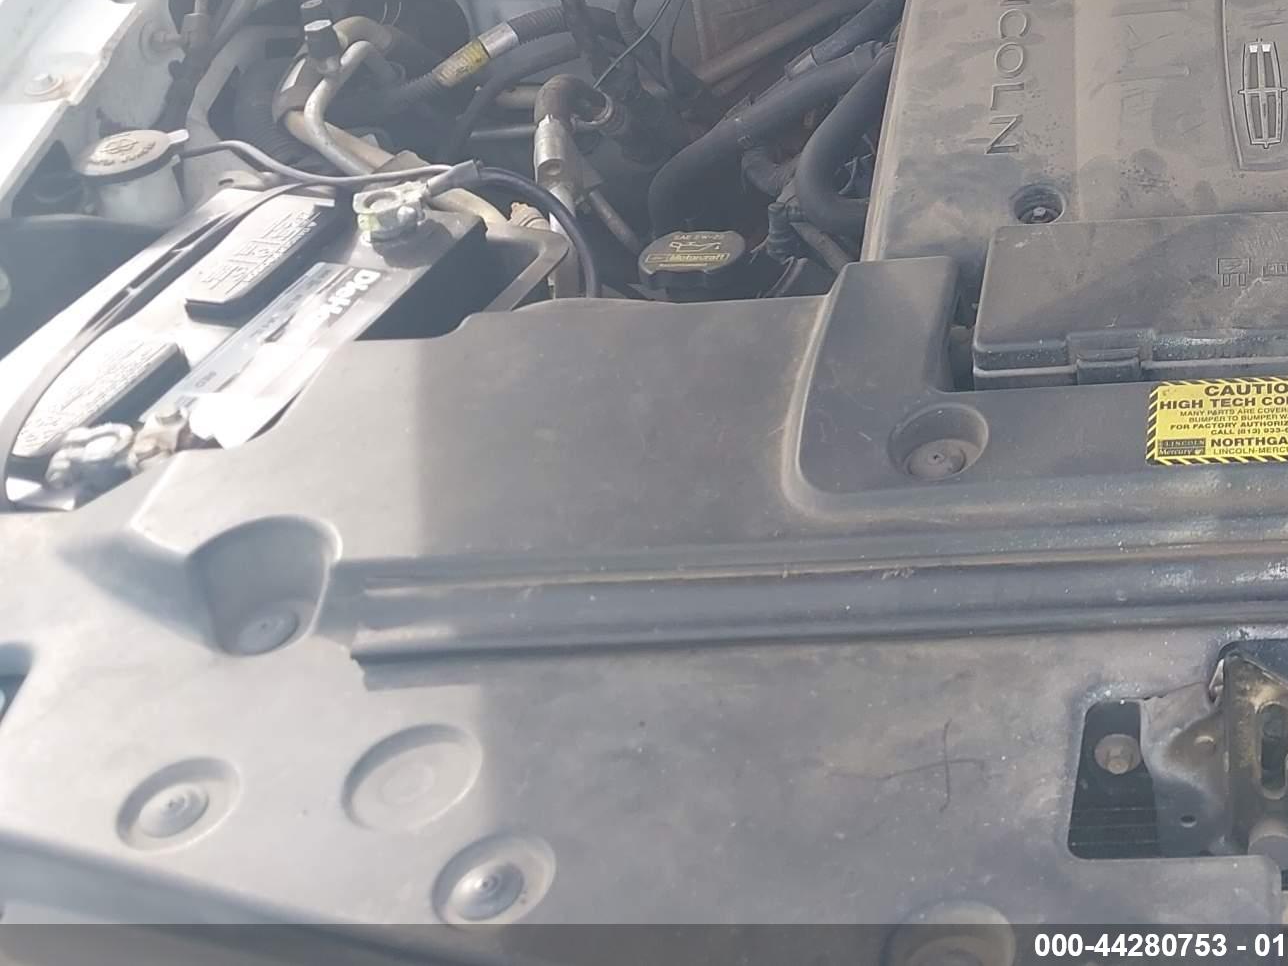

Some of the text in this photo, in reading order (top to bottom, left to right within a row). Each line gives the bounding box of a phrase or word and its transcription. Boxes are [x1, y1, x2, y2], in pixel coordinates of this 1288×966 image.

[1160, 399, 1203, 409] HIGH
[1210, 397, 1256, 408] TECH
[1189, 415, 1227, 423] BUMPER
[1159, 447, 1192, 455] Mercury
